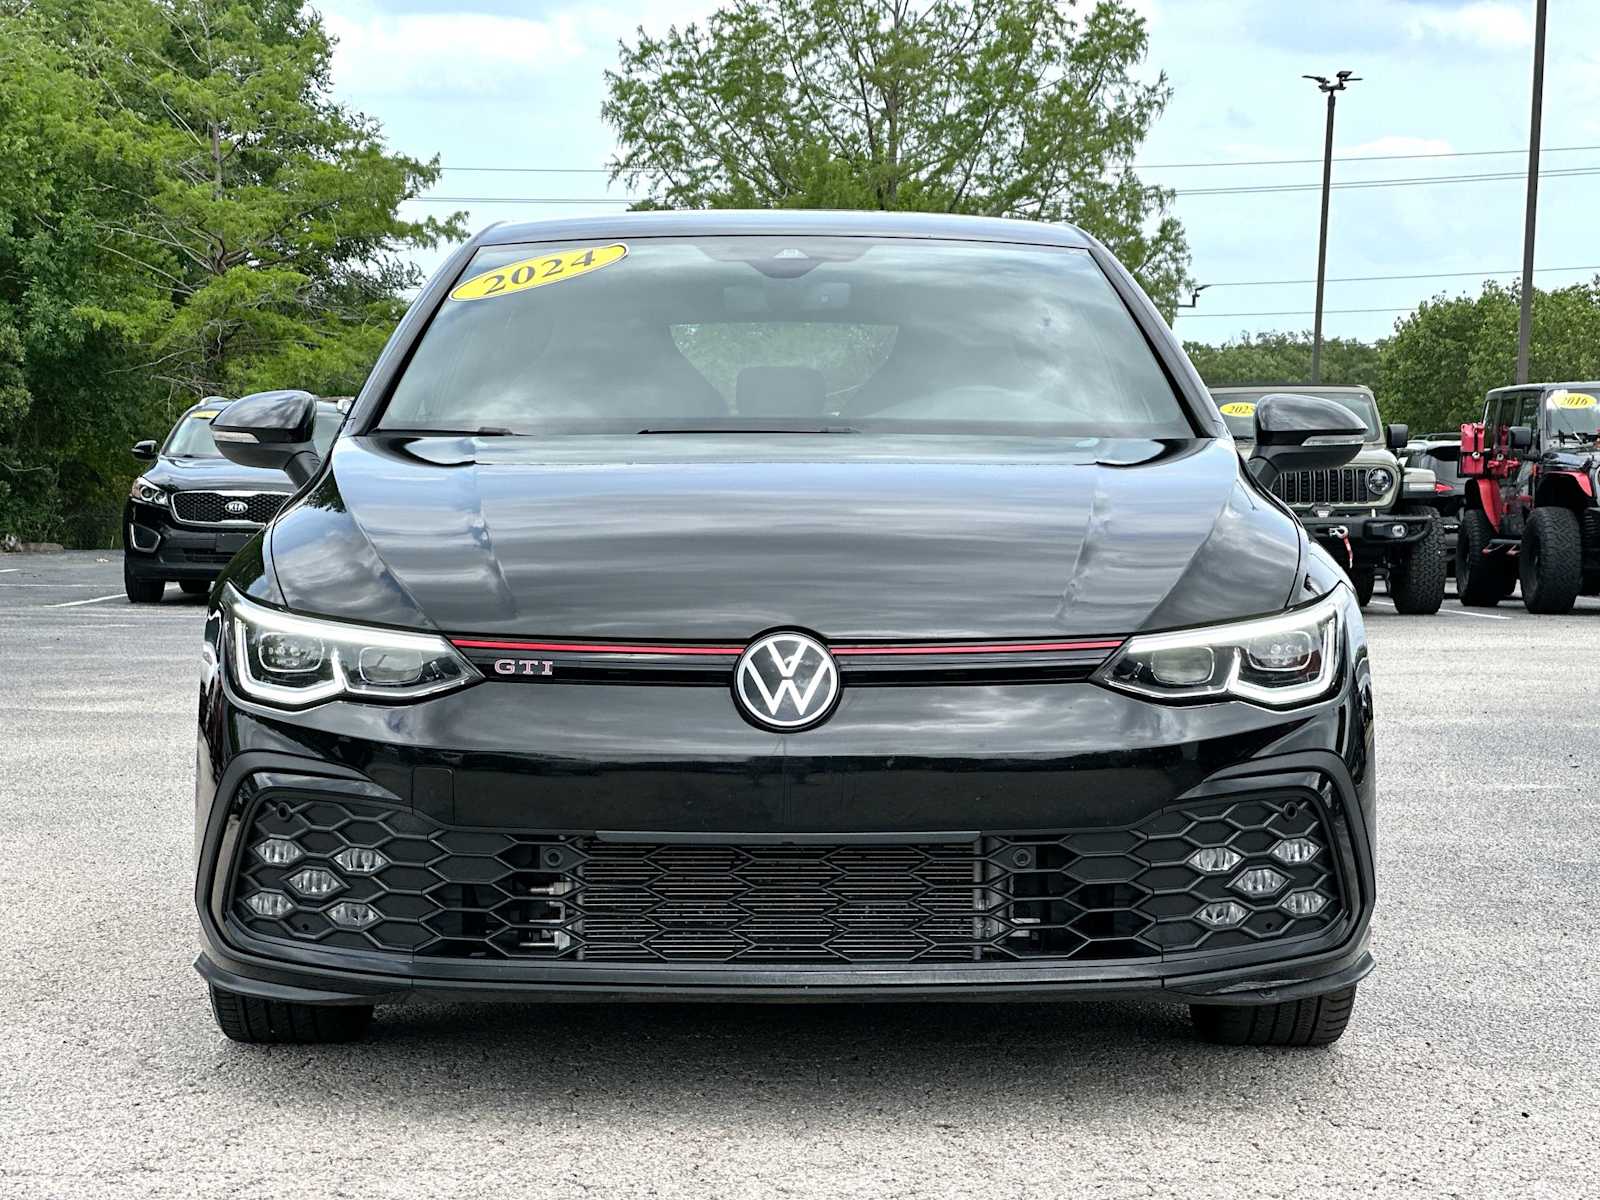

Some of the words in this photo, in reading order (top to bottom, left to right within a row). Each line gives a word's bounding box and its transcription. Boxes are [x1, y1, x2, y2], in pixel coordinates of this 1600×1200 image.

[482, 249, 596, 296] 2024
[227, 502, 247, 512] KIA
[494, 658, 553, 676] GTI
